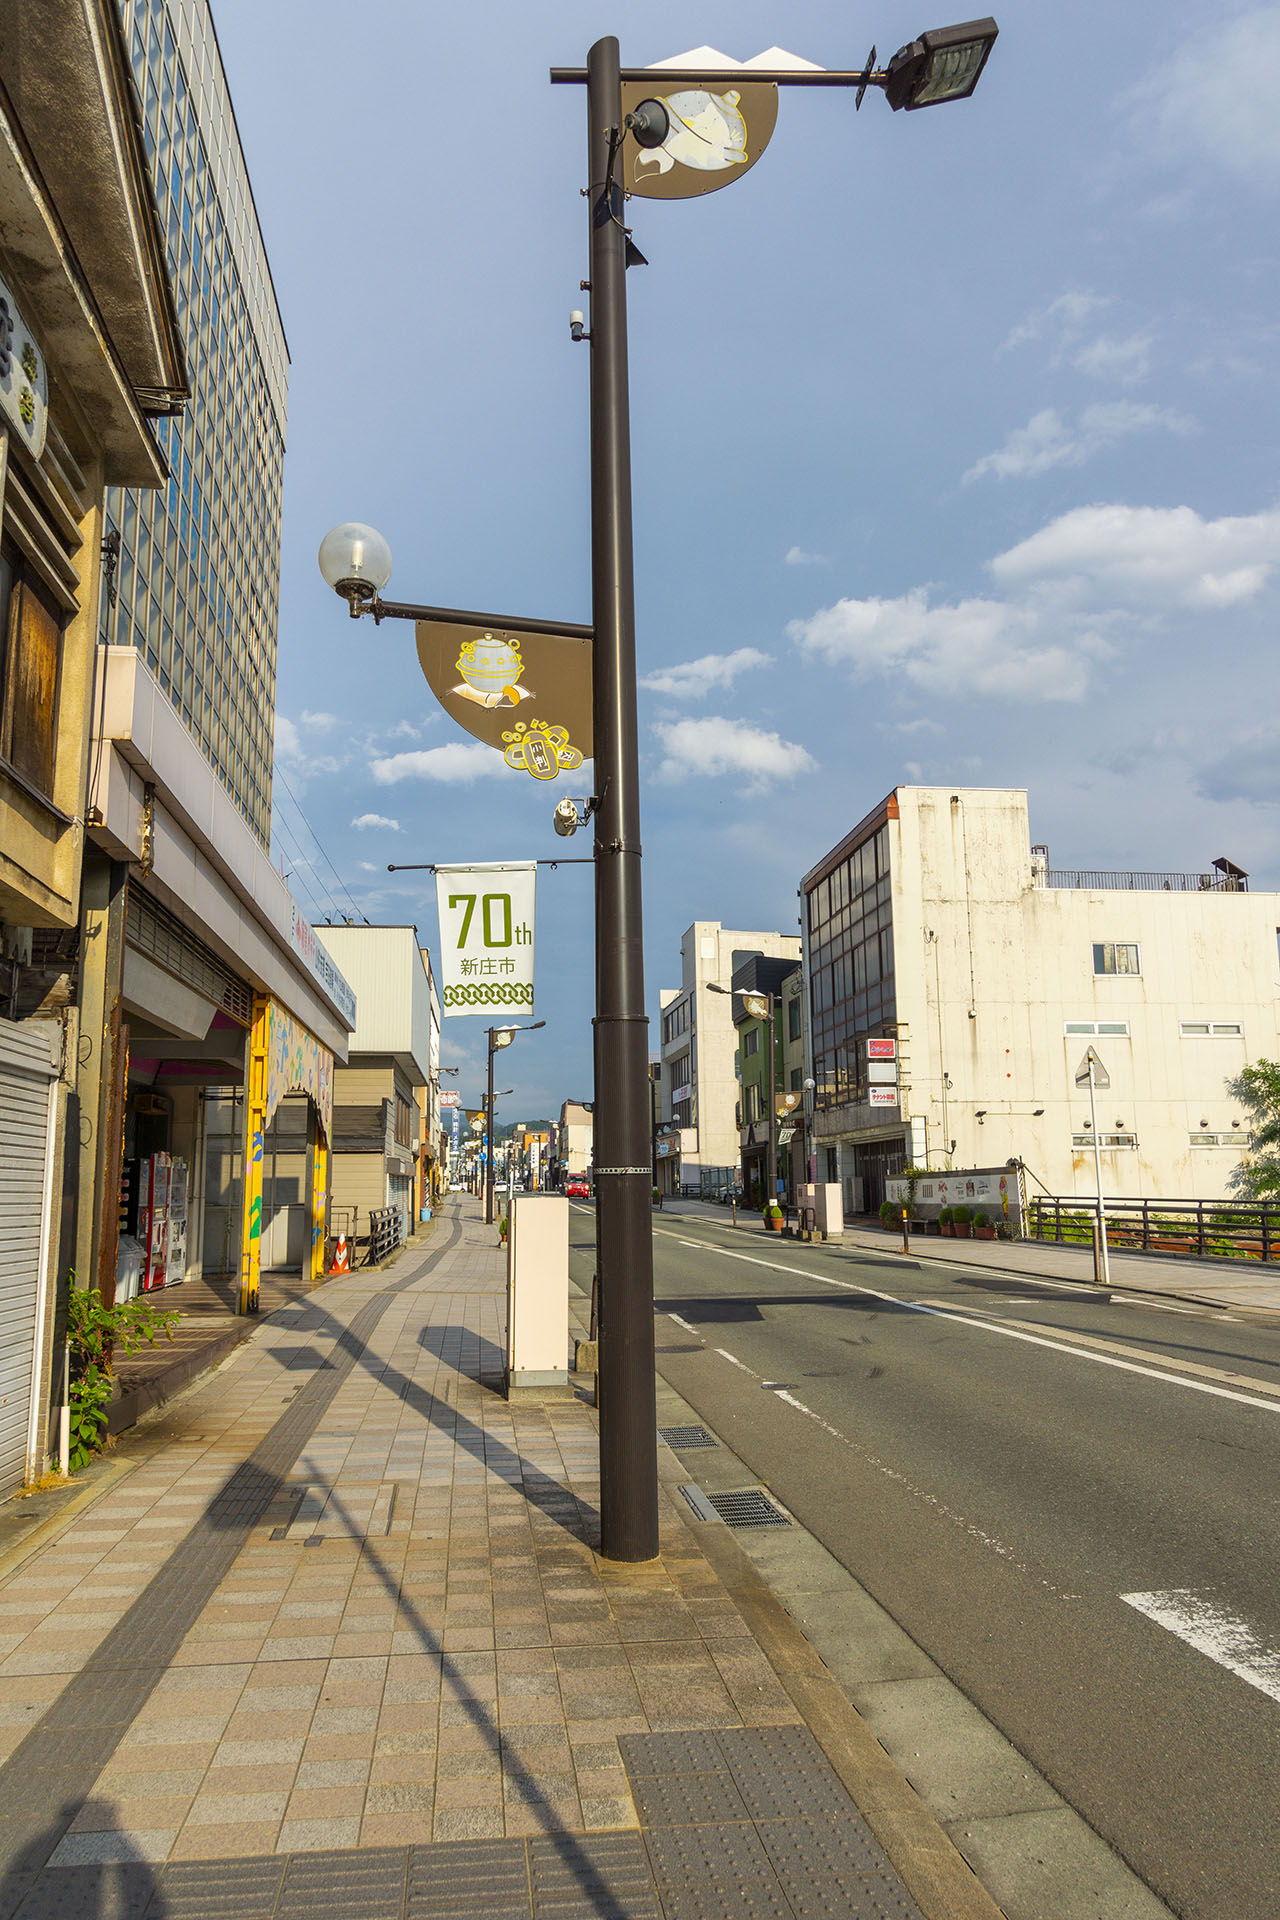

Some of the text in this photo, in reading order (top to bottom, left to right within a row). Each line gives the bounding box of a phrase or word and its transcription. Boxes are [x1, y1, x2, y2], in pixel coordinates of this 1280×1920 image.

[448, 893, 532, 949] 70th
[460, 957, 516, 976] 新庄市
